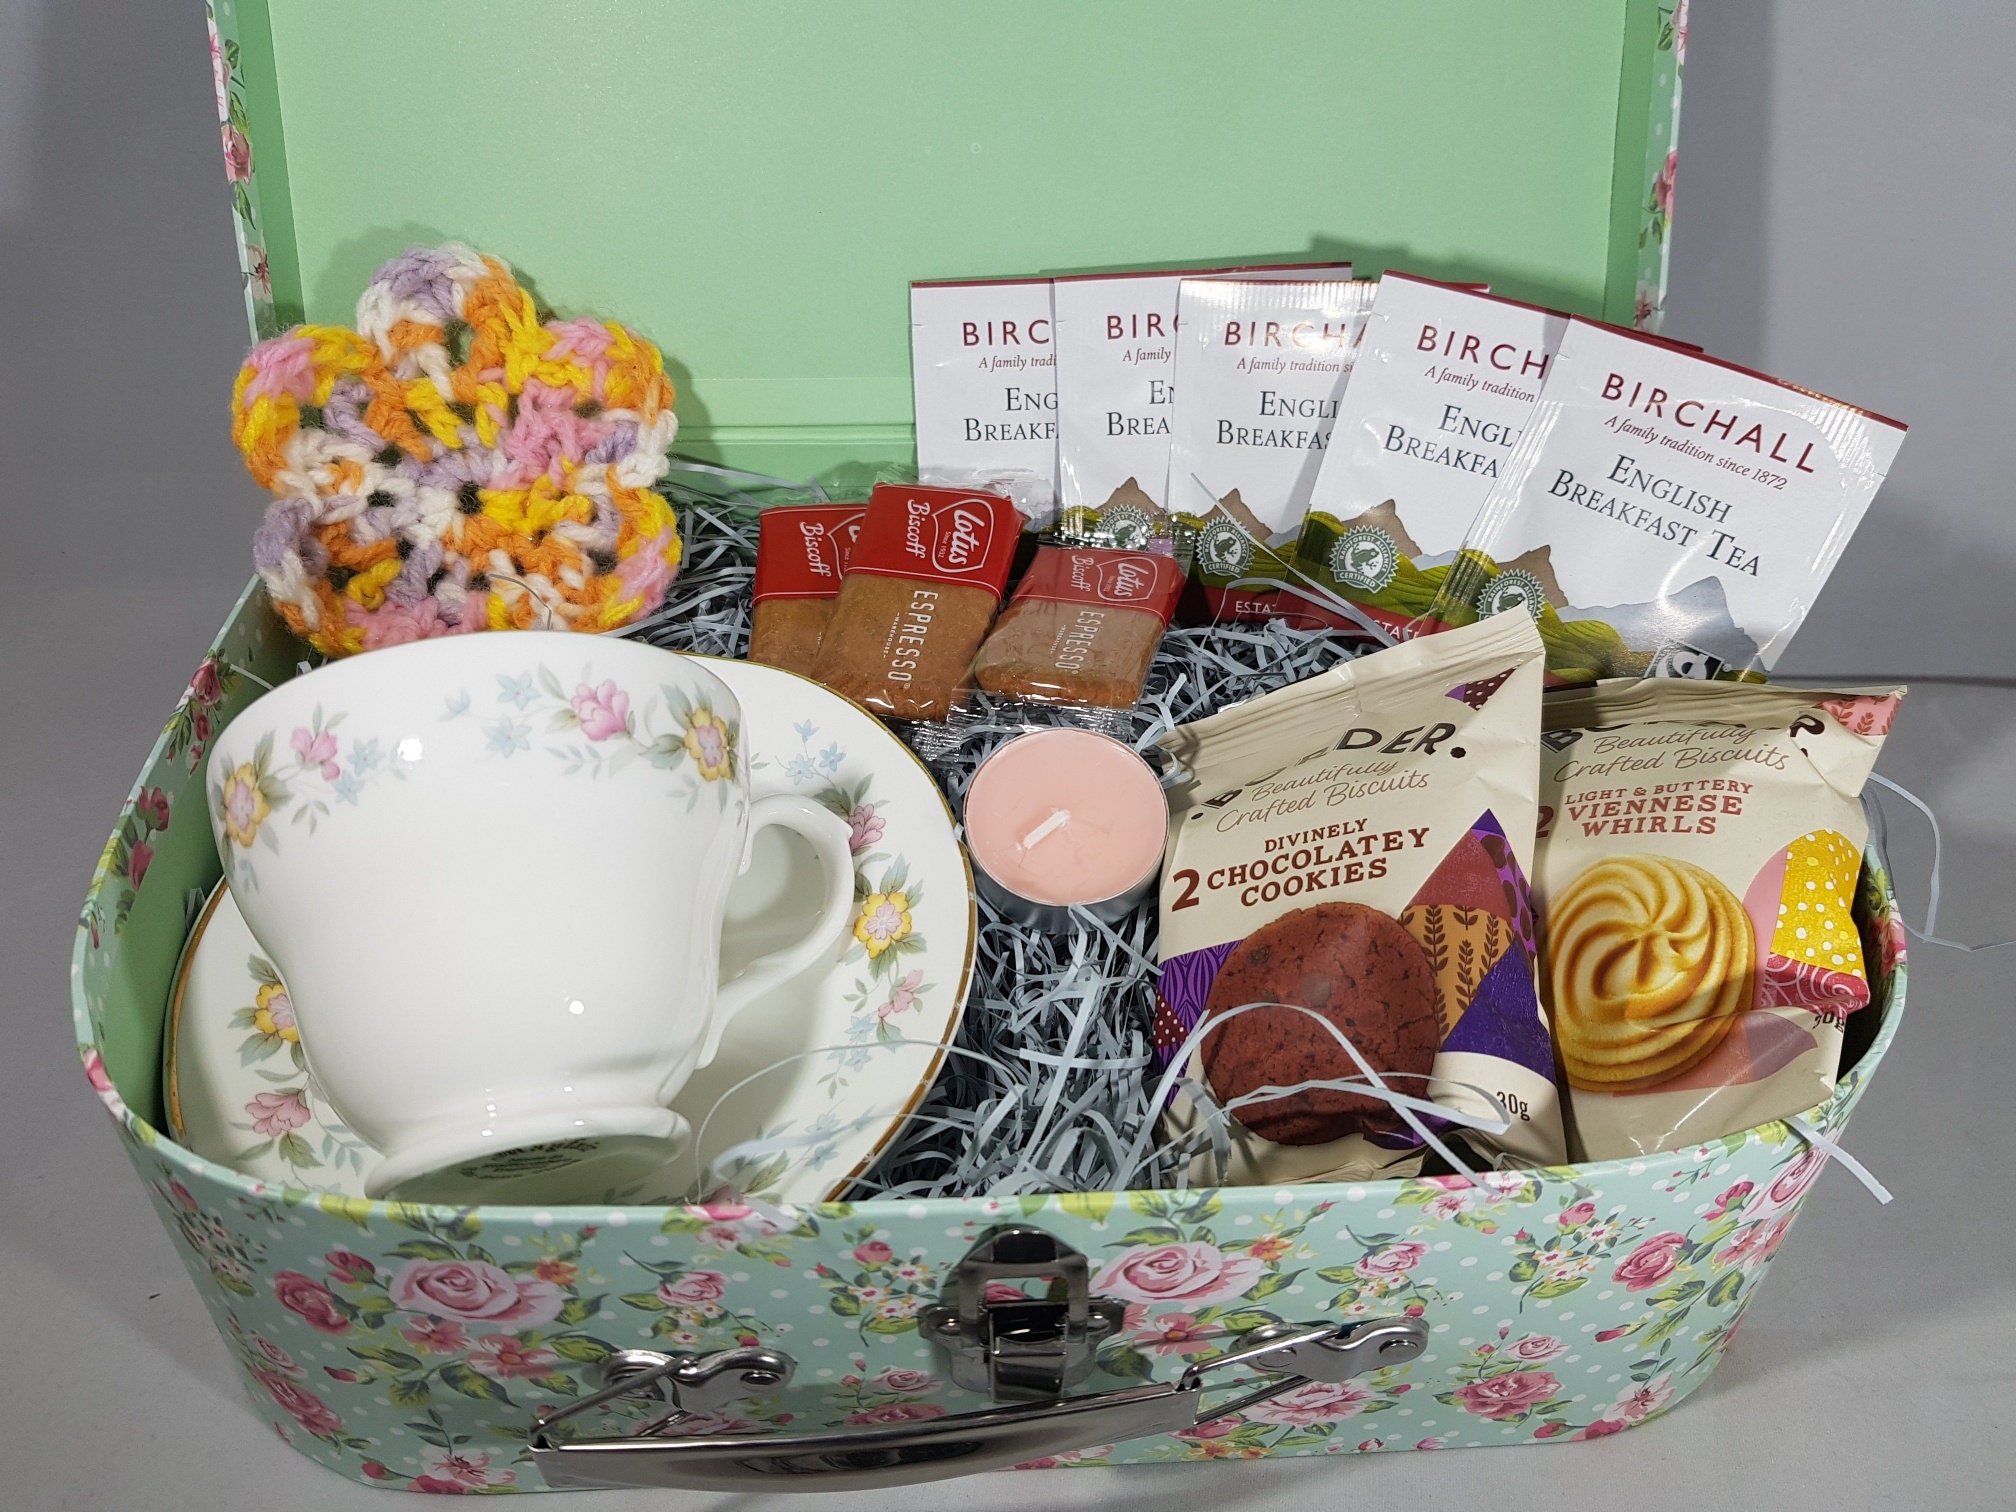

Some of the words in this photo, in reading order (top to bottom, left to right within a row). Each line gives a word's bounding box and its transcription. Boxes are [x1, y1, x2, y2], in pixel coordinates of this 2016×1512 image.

[962, 319, 1050, 346] BIRC
[979, 356, 988, 369] A
[989, 354, 1026, 372] family
[1122, 349, 1132, 362] A
[1134, 346, 1171, 365] family
[1237, 357, 1246, 370] A
[1248, 356, 1286, 374] family
[1290, 357, 1340, 373] tradition
[1416, 325, 1549, 379] BIRCH
[1424, 366, 1437, 379] A
[1435, 367, 1479, 391] family
[1482, 380, 1535, 402] tradition
[963, 417, 1059, 442] BREAKF
[1106, 411, 1171, 436] BREA
[1437, 404, 1522, 448] ENGL
[1601, 373, 1815, 474] BIRCHALL
[1384, 424, 1499, 479] BREAKFA
[1604, 414, 1618, 428] A
[1612, 417, 1659, 444] family
[1660, 436, 1715, 463] tradition
[1716, 455, 1751, 476] since
[1751, 468, 1787, 490] 1872
[1606, 454, 1733, 524] ENGLISH
[1547, 469, 1698, 548] BREAKFAST
[905, 499, 931, 559] Biscoff
[948, 509, 985, 566] Lotus
[1204, 526, 1230, 552] RAINFOREST
[800, 521, 832, 577] Biscoff
[1340, 535, 1375, 559] RAINFOREST
[1376, 541, 1389, 572] ALLIANCE
[1071, 555, 1094, 592] Biscoff
[1113, 562, 1149, 597] Lotus
[1208, 563, 1241, 573] CERTIFIED
[1340, 572, 1376, 587] CERTIFIED
[1488, 579, 1524, 602] RAINFOREST
[887, 590, 938, 682] ESPRESSO
[1055, 610, 1105, 669] ESPRESSO
[1251, 760, 1399, 802] Beautifully
[1553, 752, 1664, 783] Crafted
[1674, 744, 1791, 771] Biscuits
[1216, 790, 1316, 833] Crafted
[1323, 770, 1430, 807] Biscuits
[1564, 787, 1627, 805] LIGHT
[1633, 786, 1647, 797] &
[1654, 779, 1754, 796] BUTTERY
[1568, 794, 1744, 821] VIENNESE
[1264, 818, 1368, 853] DIVINELY
[1582, 815, 1718, 837] WHIRLS
[1171, 868, 1200, 912] 2
[1207, 827, 1430, 890] CHOCOLATEY
[1241, 857, 1388, 907] COOKIES
